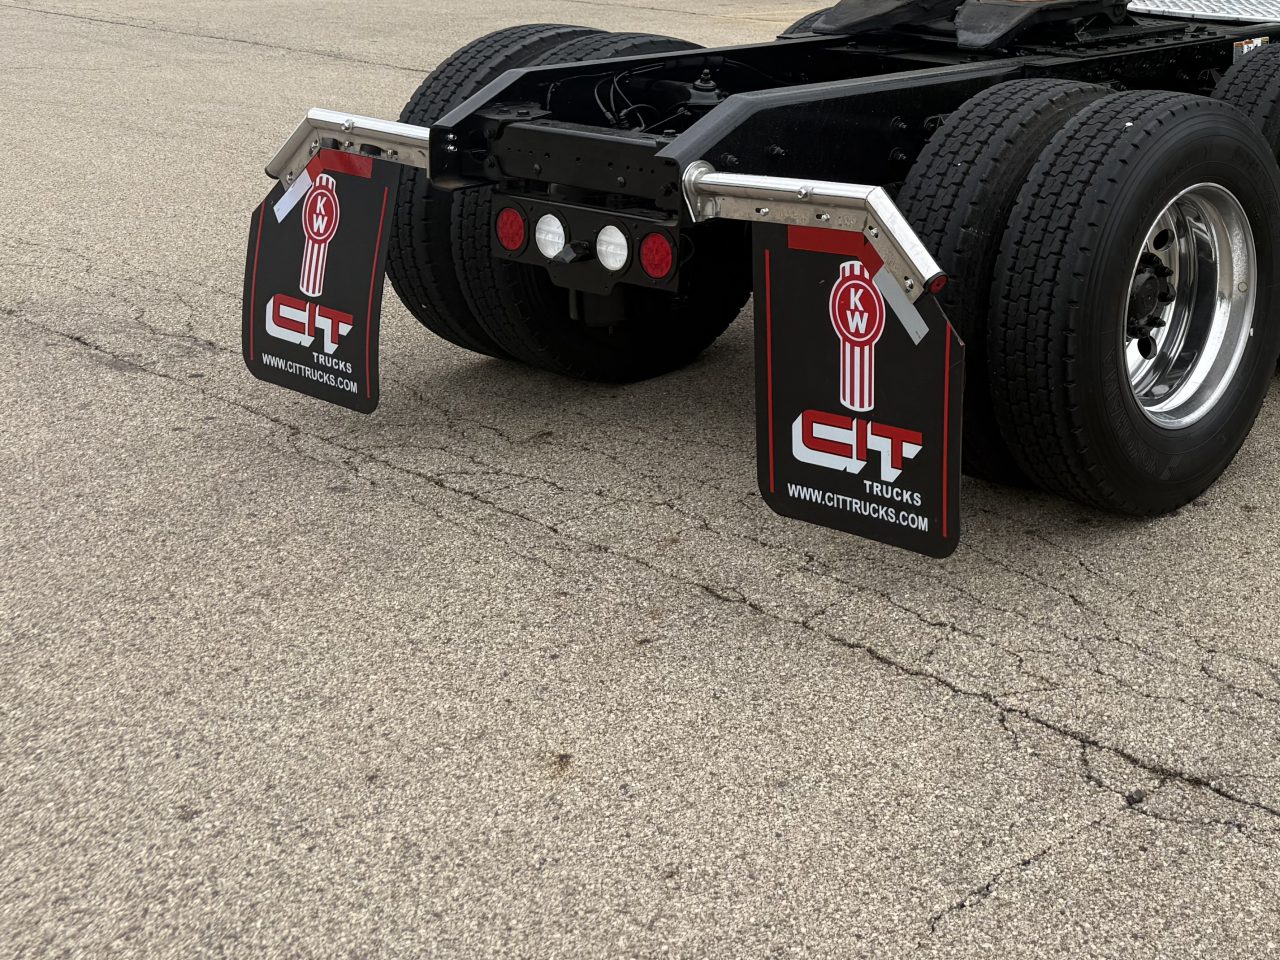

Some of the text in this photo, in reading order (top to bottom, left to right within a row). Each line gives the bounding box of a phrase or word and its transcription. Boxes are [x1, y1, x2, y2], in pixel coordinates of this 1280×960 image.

[265, 293, 354, 354] CIT
[262, 352, 358, 394] WWW.CITTRUCKS.COM
[312, 351, 353, 374] TRUCKS
[792, 409, 923, 483] CIT
[787, 482, 929, 532] WWW.CITTRUCKS.COM
[863, 479, 922, 507] TRUCKS
